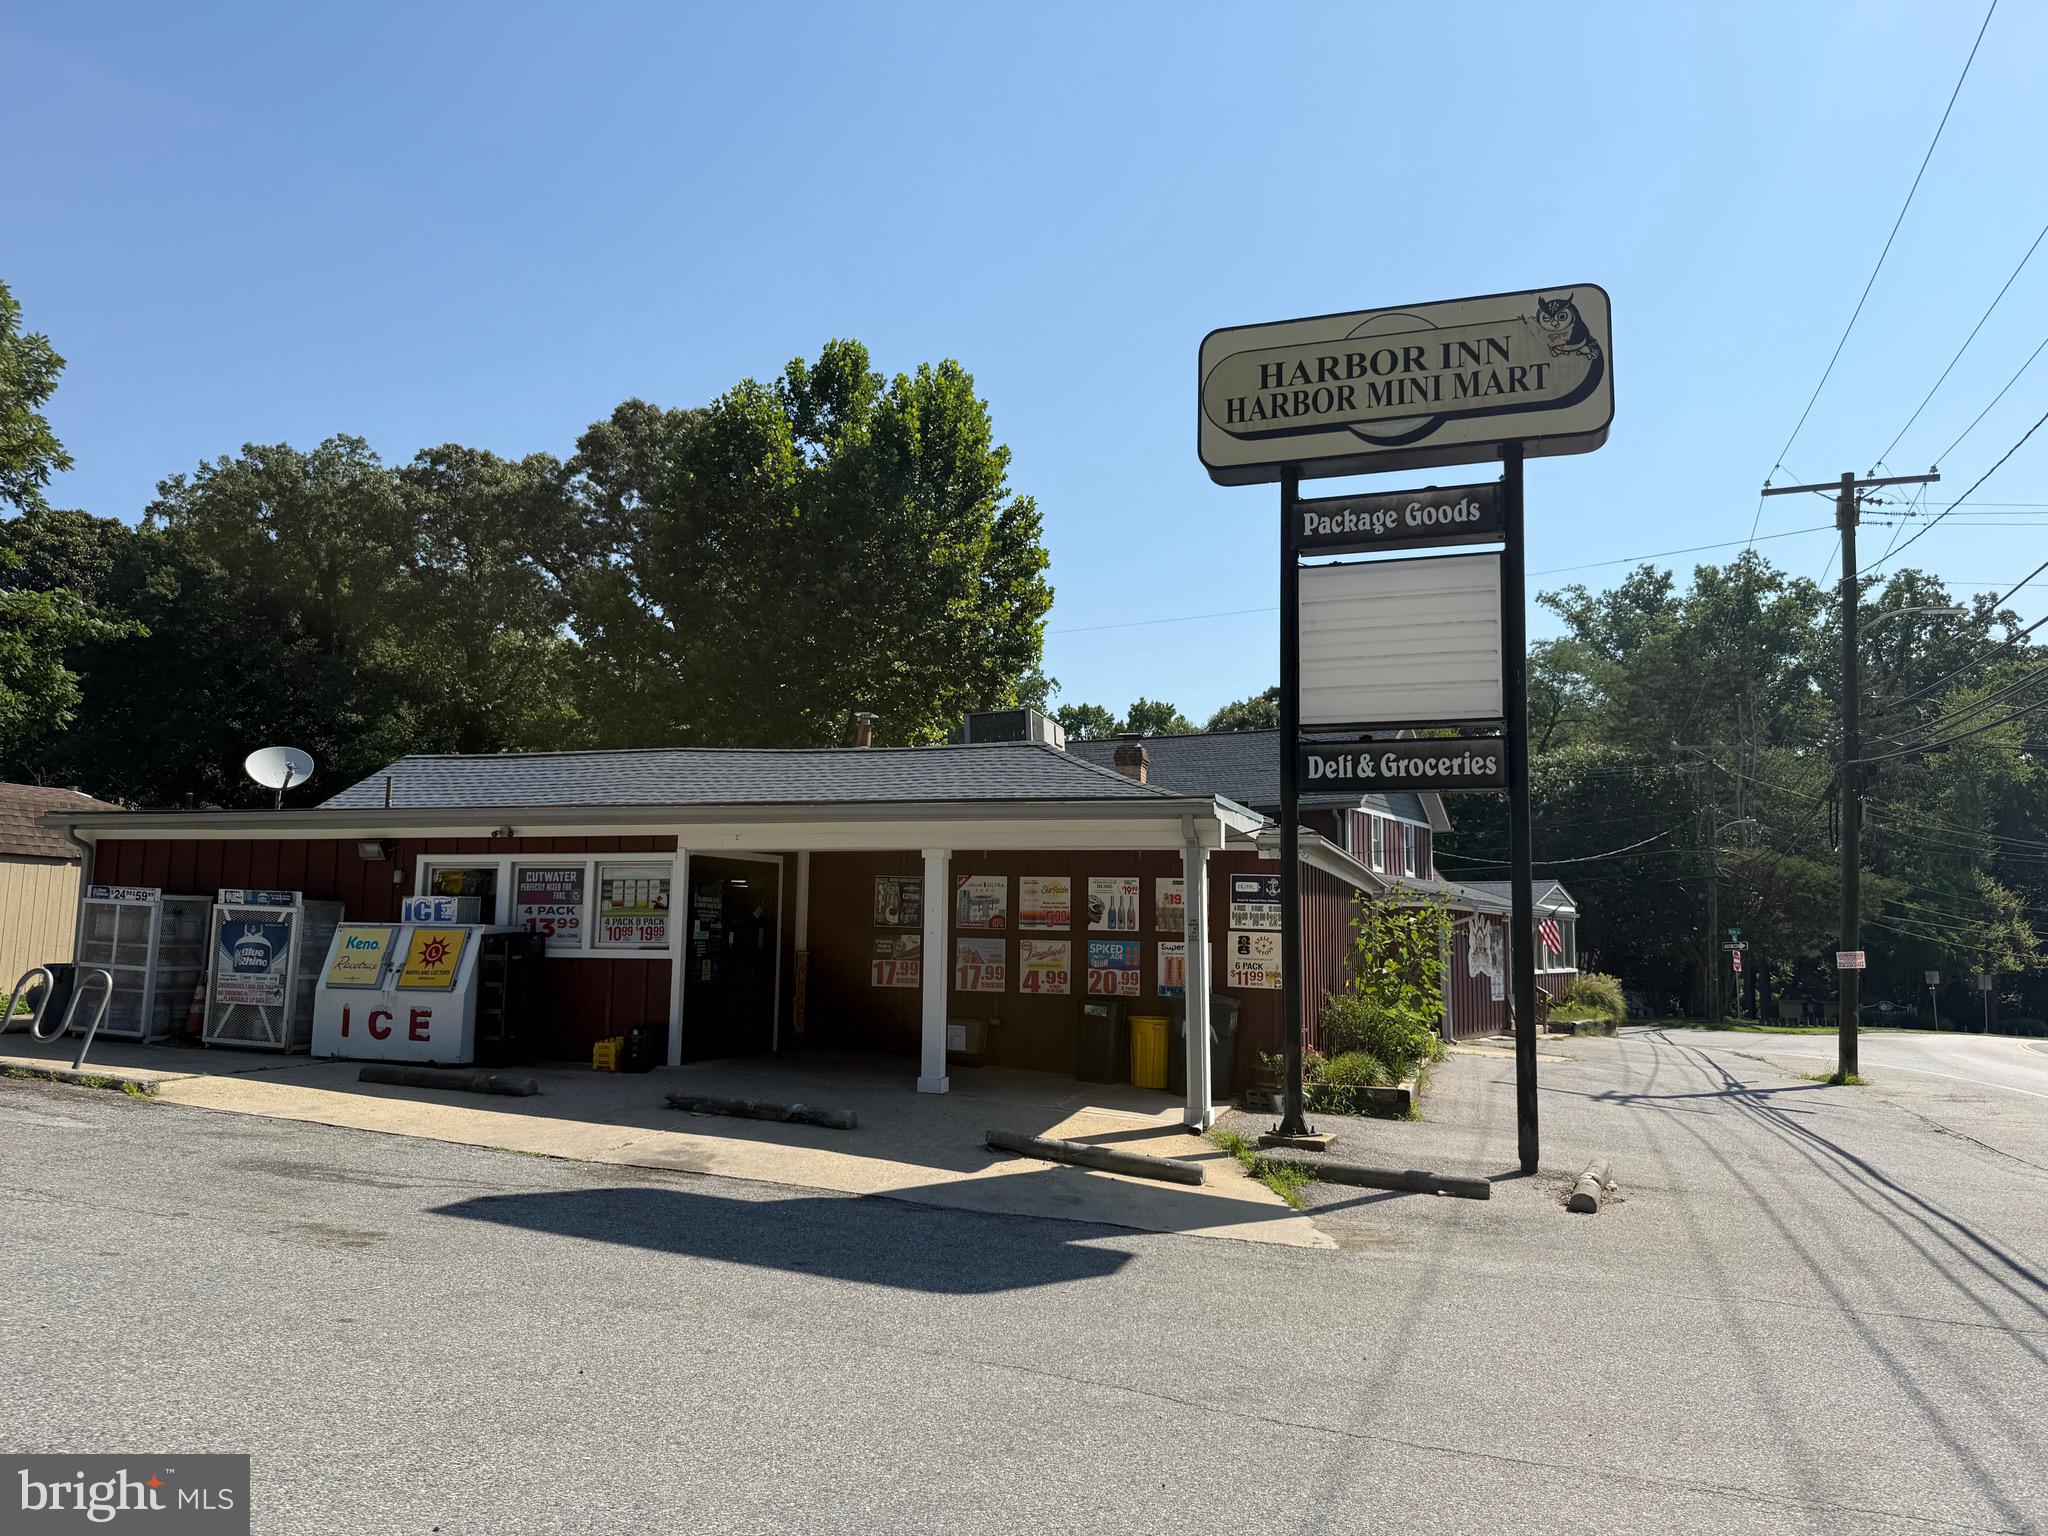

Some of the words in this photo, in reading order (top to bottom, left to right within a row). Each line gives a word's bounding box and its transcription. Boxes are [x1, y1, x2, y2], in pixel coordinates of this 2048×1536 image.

[1257, 346, 1430, 390] HARBOR
[1440, 335, 1512, 374] INN
[1224, 384, 1358, 424] HARBOR
[1366, 374, 1443, 409] MINI
[1452, 363, 1550, 400] MART
[1303, 509, 1399, 535] Package
[1405, 498, 1481, 527] Goods
[1307, 754, 1353, 779] Deli
[1356, 753, 1376, 778] &
[1380, 751, 1497, 778] Groceries
[526, 871, 577, 882] CUTWATER
[562, 883, 572, 891] FOR
[1041, 885, 1069, 895] Surfside
[1163, 893, 1184, 906] $19.
[404, 898, 453, 922] ICE
[524, 906, 533, 915] 4
[537, 906, 576, 915] PACK
[241, 947, 265, 957] Blue
[334, 956, 378, 972] Racetrax
[873, 961, 919, 986] 17.99
[1243, 962, 1263, 970] PACK
[957, 964, 1005, 990] 17.99
[1022, 970, 1068, 992] 4.99
[1088, 970, 1139, 994] 20.99
[342, 1005, 433, 1042] ICE
